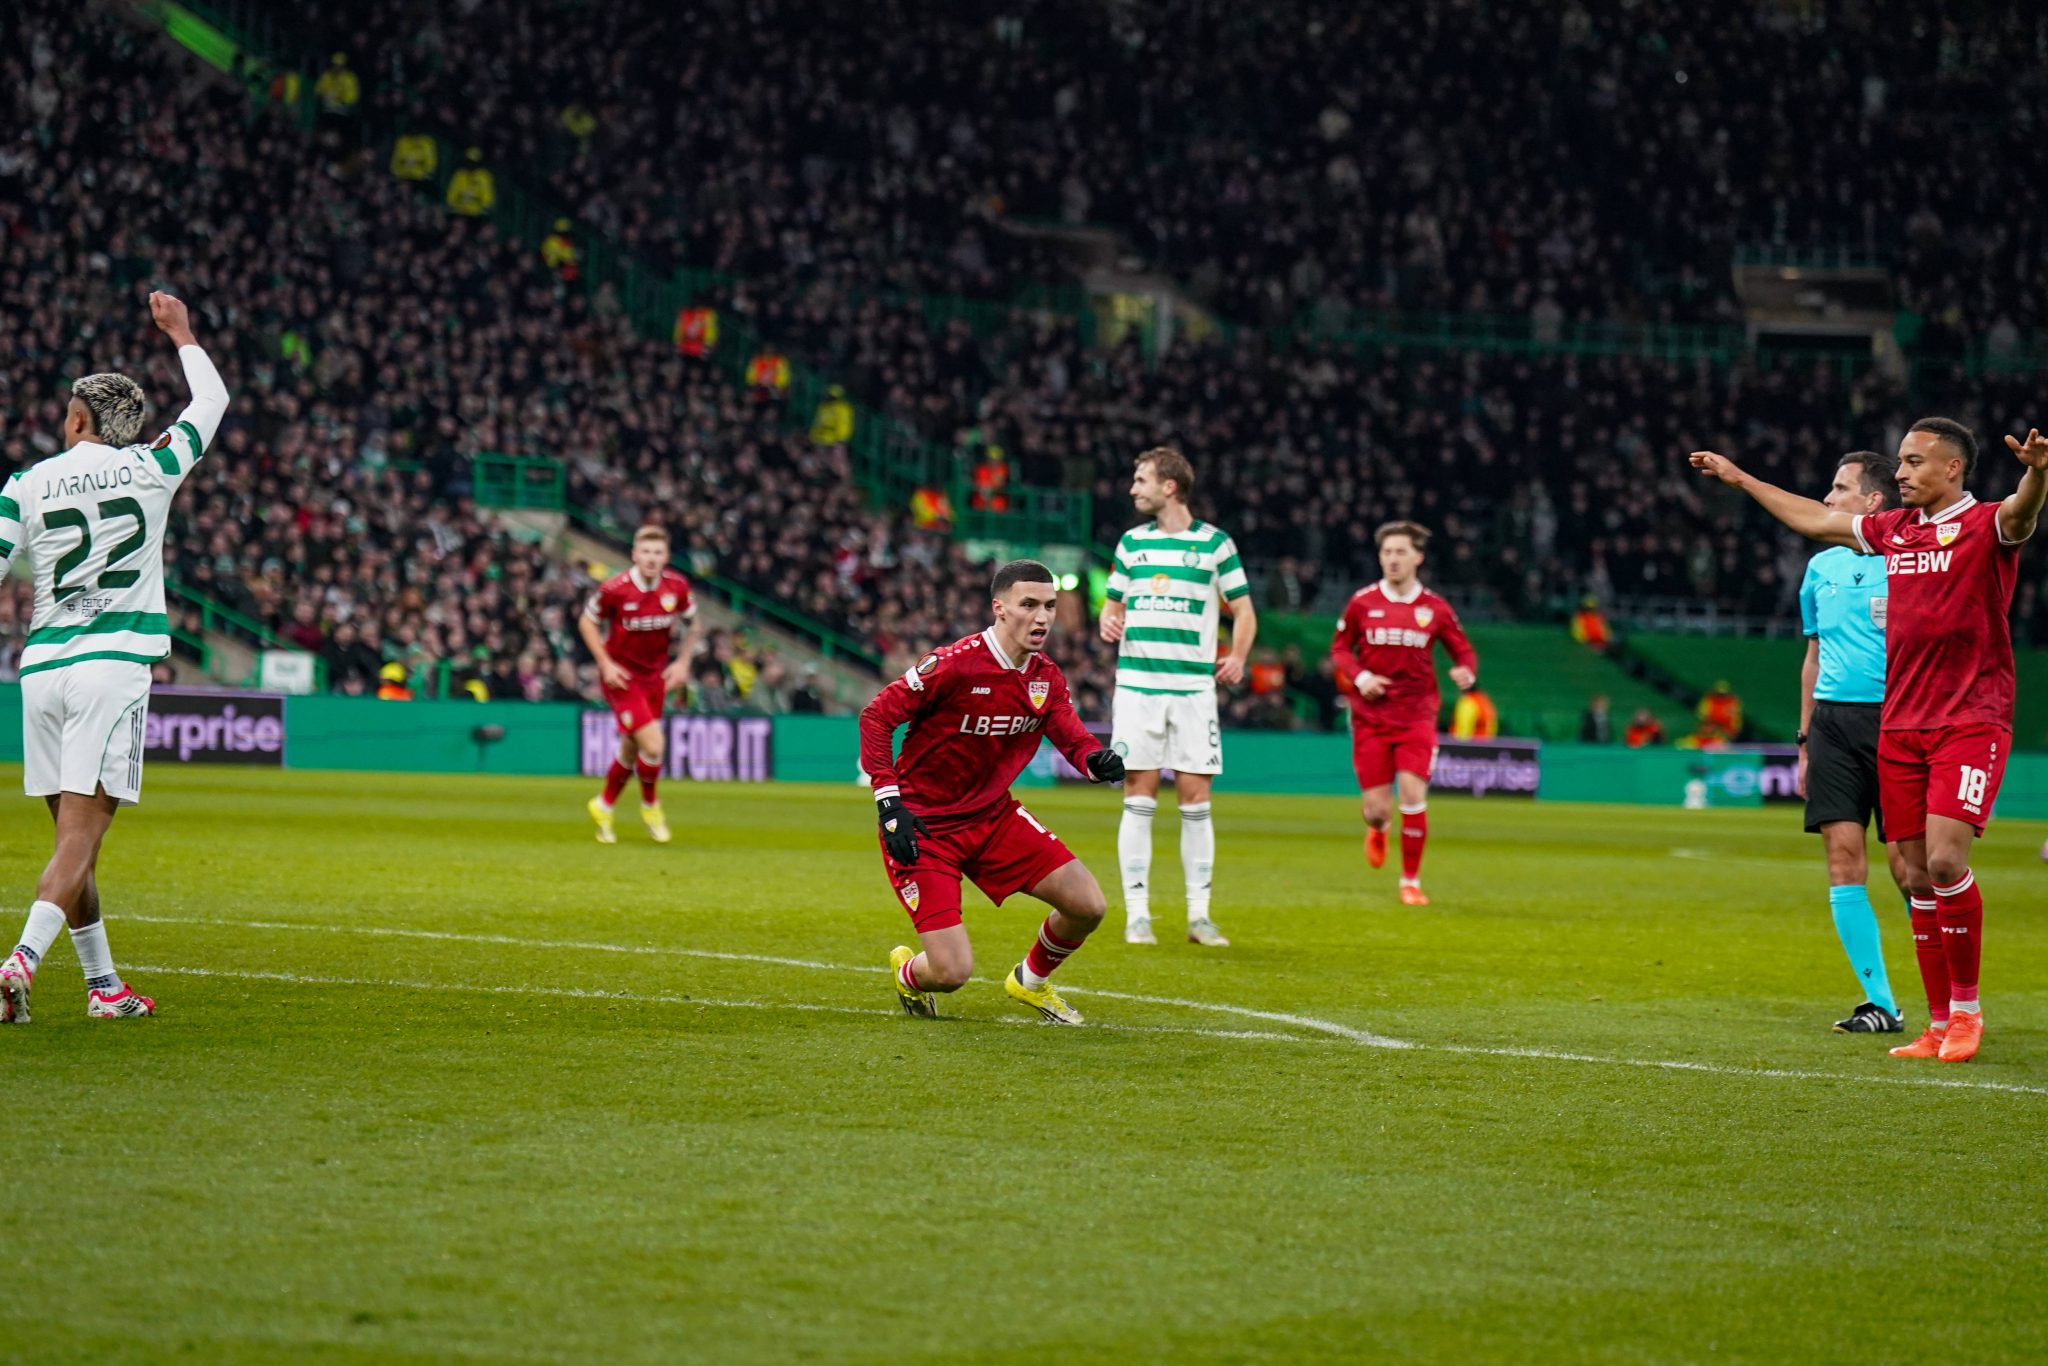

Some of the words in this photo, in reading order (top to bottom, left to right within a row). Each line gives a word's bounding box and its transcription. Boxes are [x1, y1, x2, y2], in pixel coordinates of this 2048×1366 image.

[42, 466, 132, 500] J.ARAUJO
[42, 496, 147, 604] 22
[670, 715, 733, 781] FOR
[1957, 764, 1988, 807] 18
